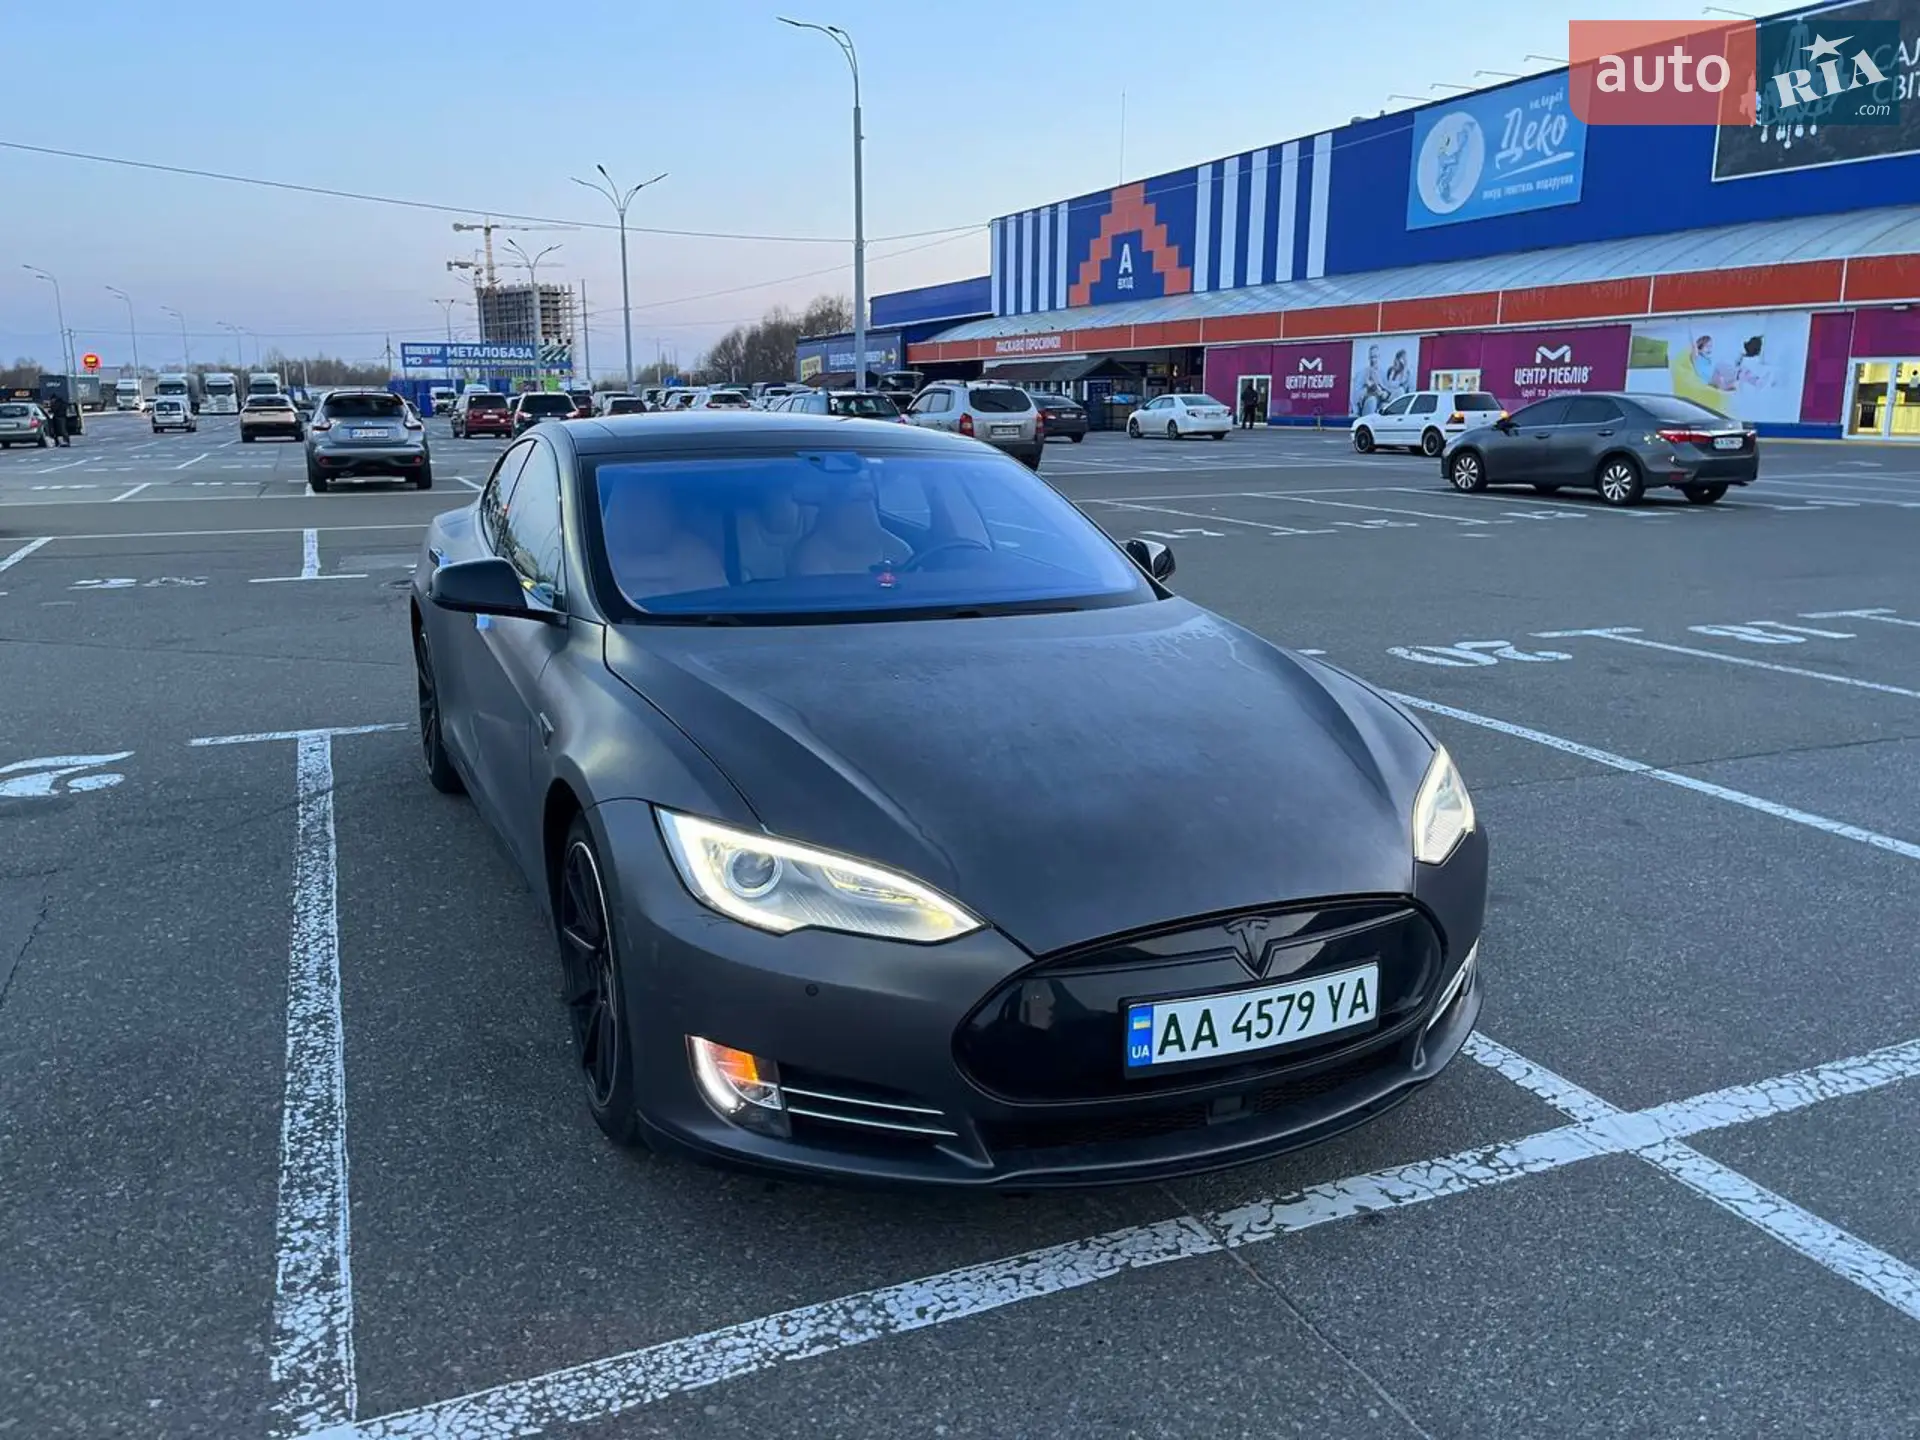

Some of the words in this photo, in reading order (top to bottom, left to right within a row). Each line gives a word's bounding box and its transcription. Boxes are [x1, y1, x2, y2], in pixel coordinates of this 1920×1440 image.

[1495, 107, 1568, 169] Деко
[446, 346, 533, 358] МЕТАЛОБАЗА
[1514, 366, 1547, 386] ЦЕНТР
[1158, 1009, 1218, 1055] AA
[1231, 990, 1315, 1042] 4579
[1328, 977, 1369, 1023] YA
[1132, 1045, 1150, 1058] UA
